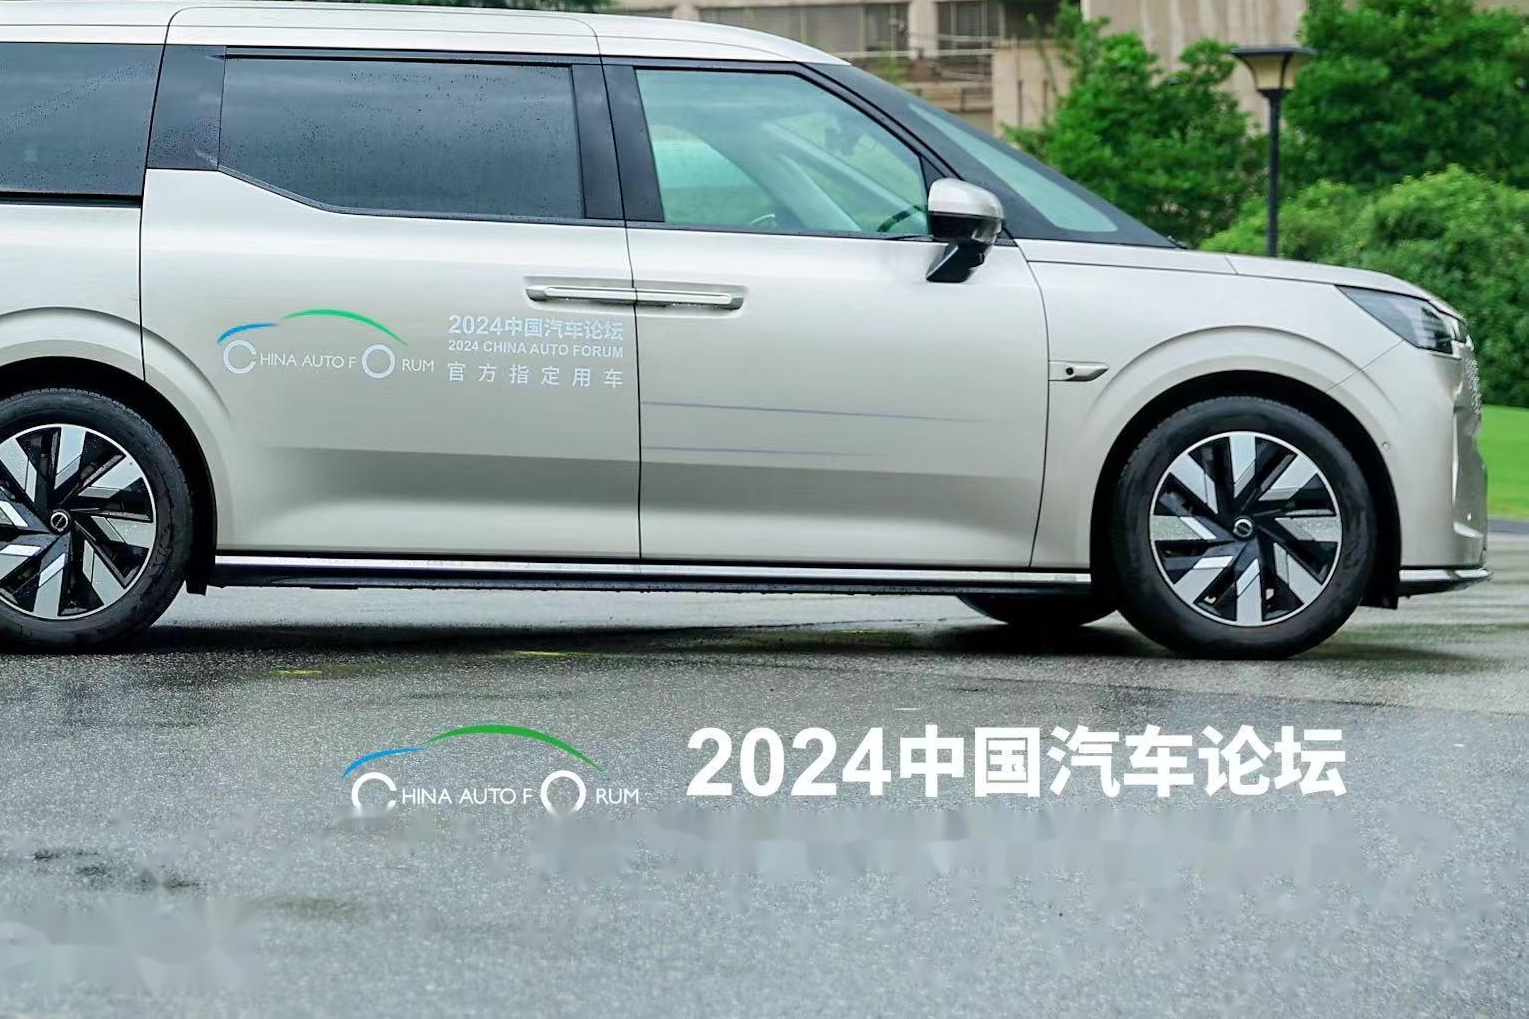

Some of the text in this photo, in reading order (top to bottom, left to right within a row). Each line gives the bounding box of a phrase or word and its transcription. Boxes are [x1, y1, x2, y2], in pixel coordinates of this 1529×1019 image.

[447, 314, 624, 341] 2024中国汽车论坛
[223, 339, 297, 374] CHINA
[301, 355, 344, 369] AUTO
[448, 340, 624, 358] 2024 CHINA AUTO FORUM
[447, 361, 624, 388] 官方指定用车
